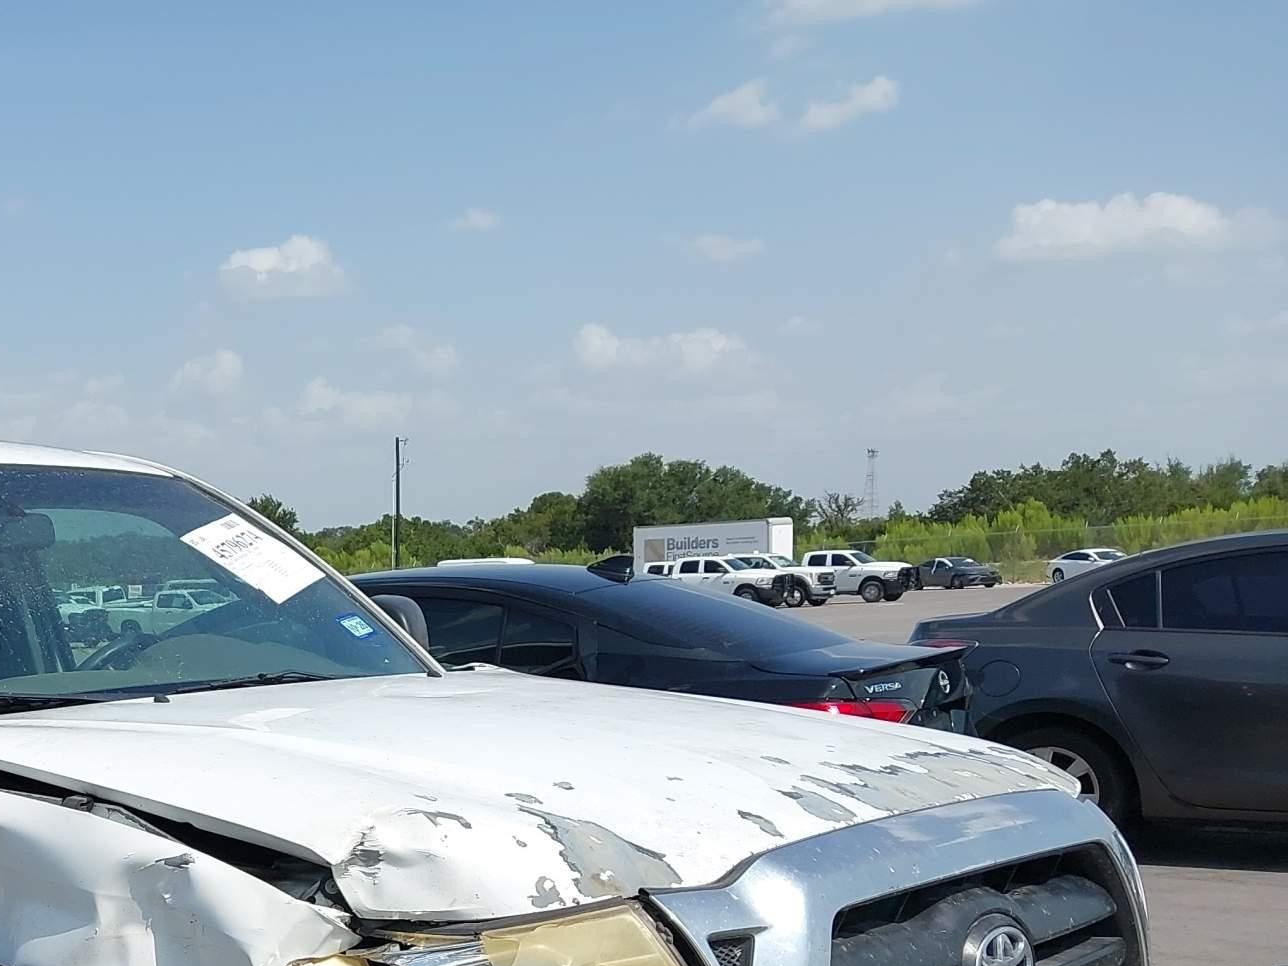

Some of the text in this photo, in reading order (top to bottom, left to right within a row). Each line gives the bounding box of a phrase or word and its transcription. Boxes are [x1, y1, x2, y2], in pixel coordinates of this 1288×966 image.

[212, 529, 263, 559] 45796274
[666, 536, 719, 551] Builders
[864, 681, 902, 694] VERSA
